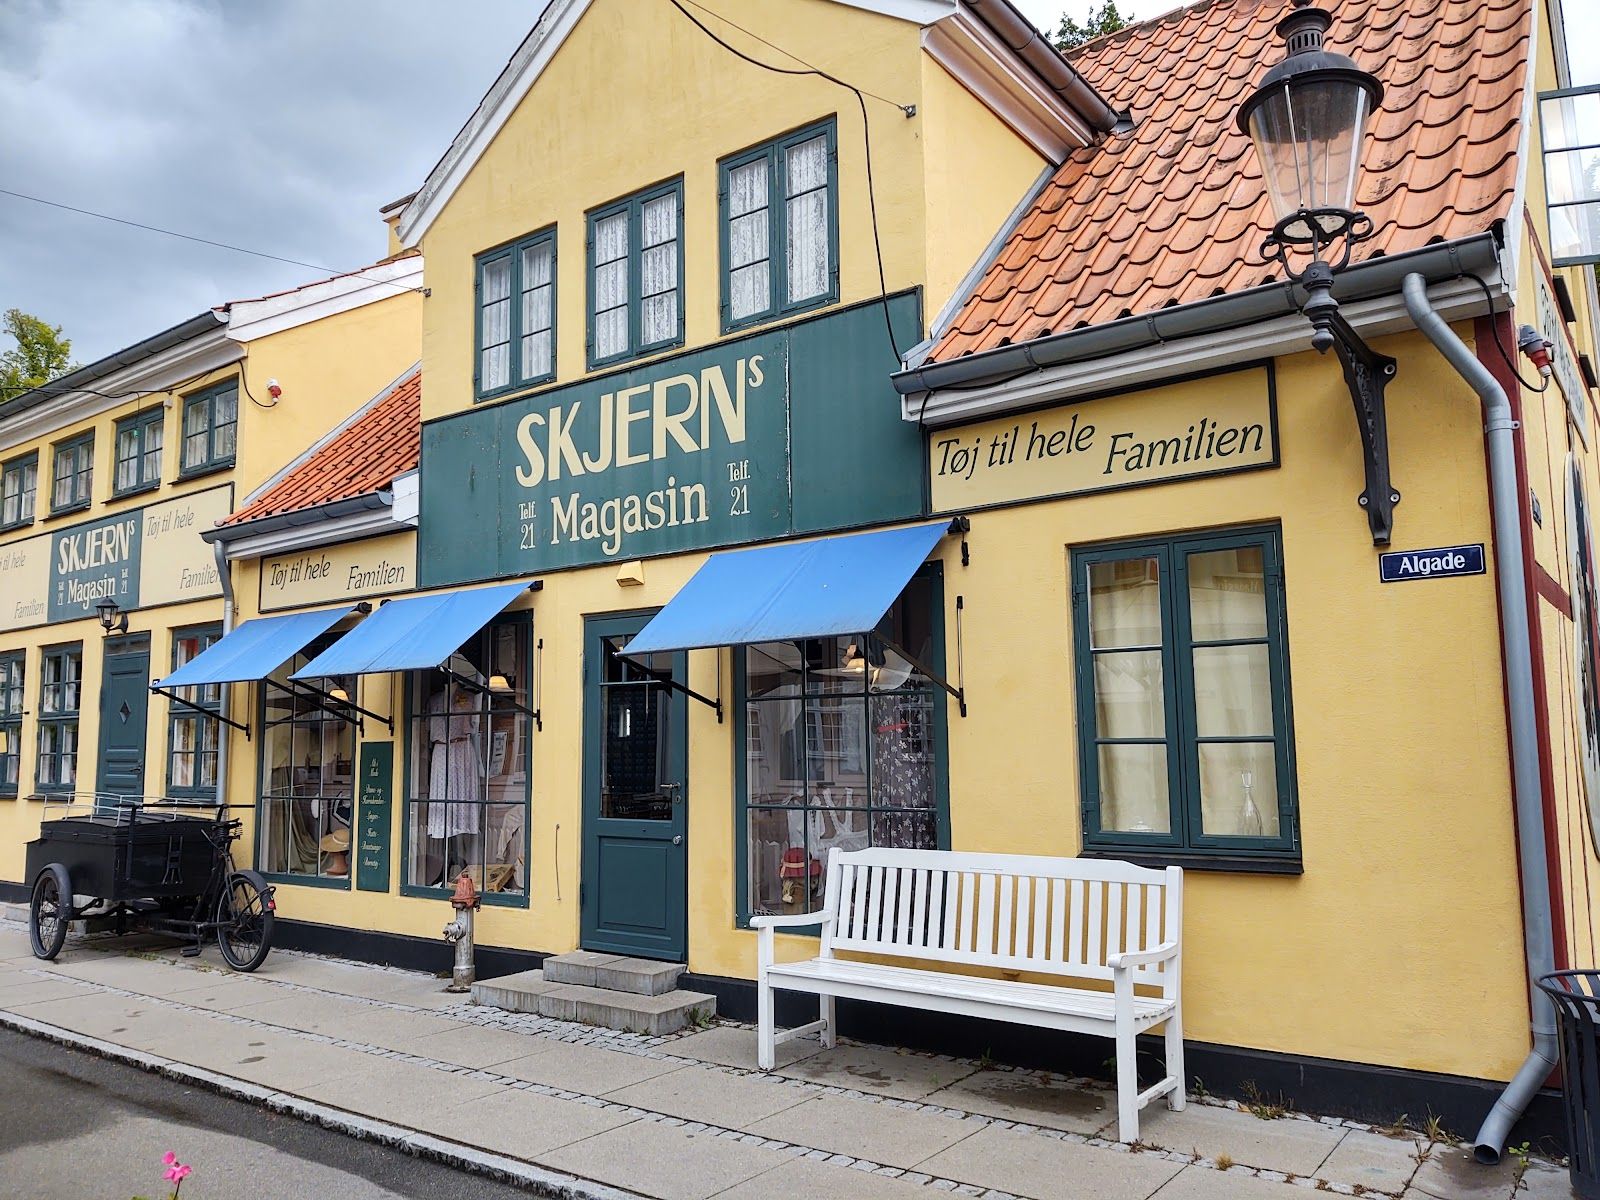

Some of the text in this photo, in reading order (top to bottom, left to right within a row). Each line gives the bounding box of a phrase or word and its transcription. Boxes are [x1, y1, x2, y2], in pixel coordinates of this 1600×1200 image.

[938, 414, 1264, 480] Tøj til hele Familien
[727, 459, 751, 481] Telf.
[550, 476, 710, 555] Magasin
[729, 484, 751, 516] 21
[173, 505, 195, 529] hele
[520, 522, 536, 550] 21
[270, 554, 405, 591] Tøj til hele Familien
[1398, 552, 1466, 575] Algade
[67, 573, 116, 610] Magasin
